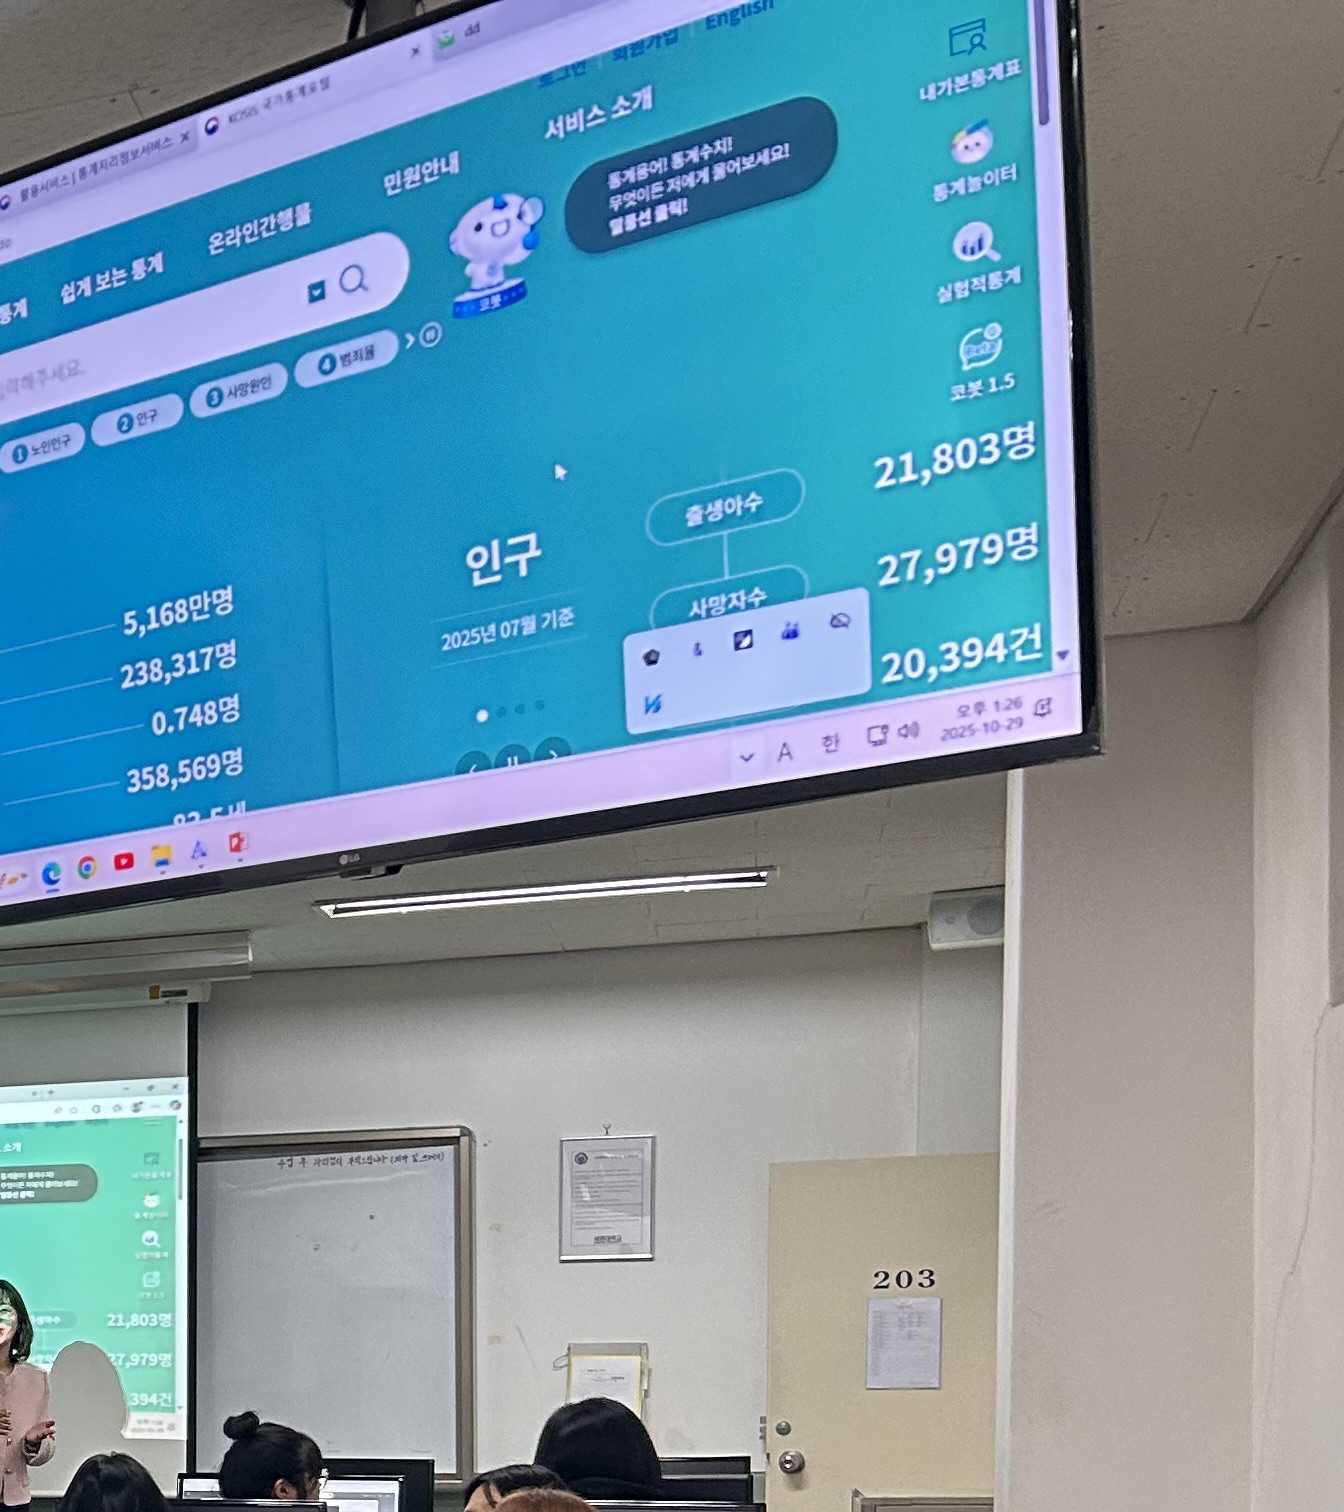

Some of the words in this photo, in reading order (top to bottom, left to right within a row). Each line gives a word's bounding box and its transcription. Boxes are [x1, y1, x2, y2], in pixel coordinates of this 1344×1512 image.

[705, 0, 774, 31] English
[919, 59, 1023, 102] 내가본통계표
[544, 104, 607, 139] 서비스
[611, 85, 653, 120] 소개
[383, 150, 460, 196] 민원안내
[932, 163, 1017, 202] 통계놀이터
[208, 202, 312, 256] 온라인간행물
[60, 276, 92, 305] 쉽게
[95, 267, 126, 293] 보는
[131, 251, 164, 281] 통계
[936, 265, 1022, 305] 실험적통계
[950, 379, 983, 403] 코봇
[988, 373, 1016, 395] 1.5
[136, 408, 159, 428] 인구
[31, 433, 72, 456] 노인인구
[873, 420, 1037, 490] 21,803명
[684, 489, 764, 527] 출생아수
[465, 532, 543, 588] 인구
[877, 522, 1041, 588] 27,979명
[122, 584, 235, 639] 5,168만명
[687, 585, 768, 621] 사망자수
[440, 619, 497, 653] 2025년
[500, 610, 539, 641] 07월
[540, 604, 576, 632] 기준
[119, 639, 239, 690] 238,317명
[880, 623, 1043, 684] 20,394건
[150, 693, 241, 738] 0.748명
[941, 716, 1024, 742] 2025-10-29
[822, 733, 840, 753] 한
[126, 746, 245, 795] 358,569명
[873, 1269, 936, 1290] 203
[107, 1312, 172, 1328] 21,803명
[130, 1392, 172, 1408] 394건
